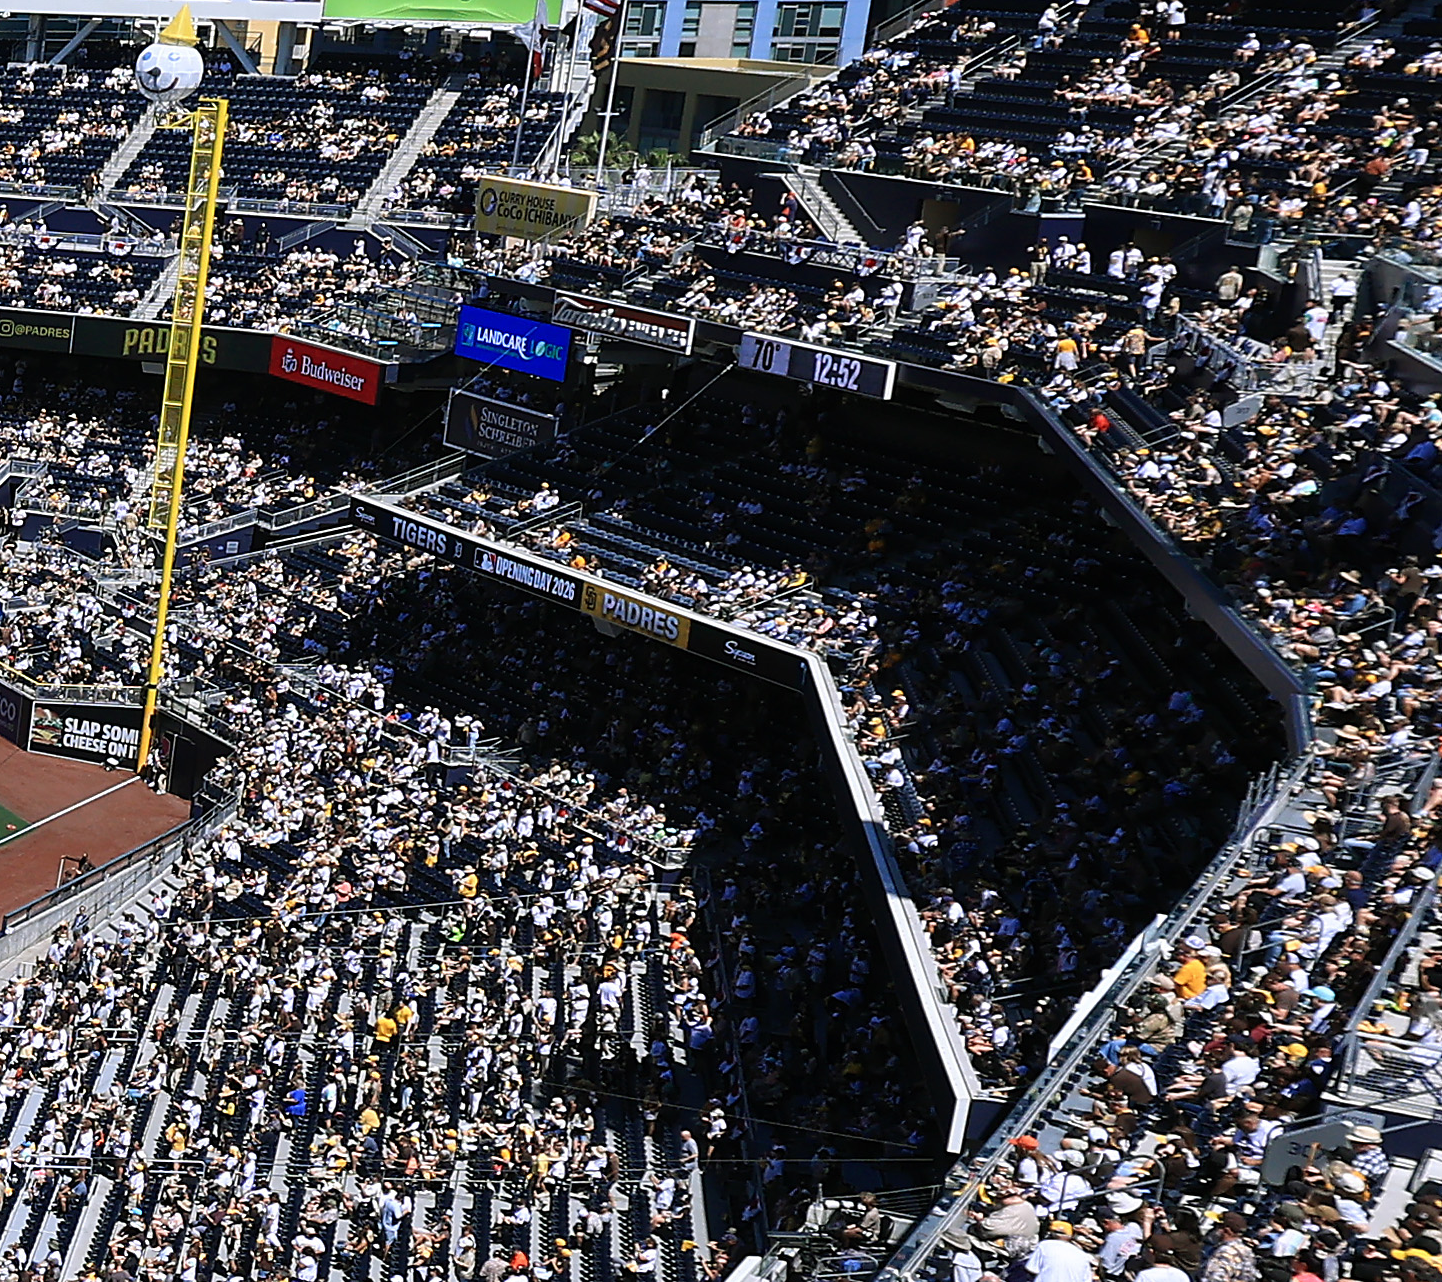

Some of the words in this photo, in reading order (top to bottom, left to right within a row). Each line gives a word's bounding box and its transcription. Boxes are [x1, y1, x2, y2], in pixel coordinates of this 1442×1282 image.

[498, 190, 526, 206] CURRY
[526, 195, 556, 211] HOUSE
[14, 323, 71, 338] @PADRES
[476, 326, 527, 352] LANDCARE
[300, 354, 365, 392] Budweiser
[813, 352, 862, 390] 12:52
[480, 406, 539, 436] SINGLETON
[392, 516, 447, 555] TIGERS
[495, 555, 535, 590] OPENING
[534, 569, 552, 593] DAY
[552, 577, 576, 601] 2026
[602, 592, 680, 640] PADRES
[64, 717, 101, 740] SLAP
[62, 732, 107, 754] CHEESE
[108, 738, 127, 758] ON
